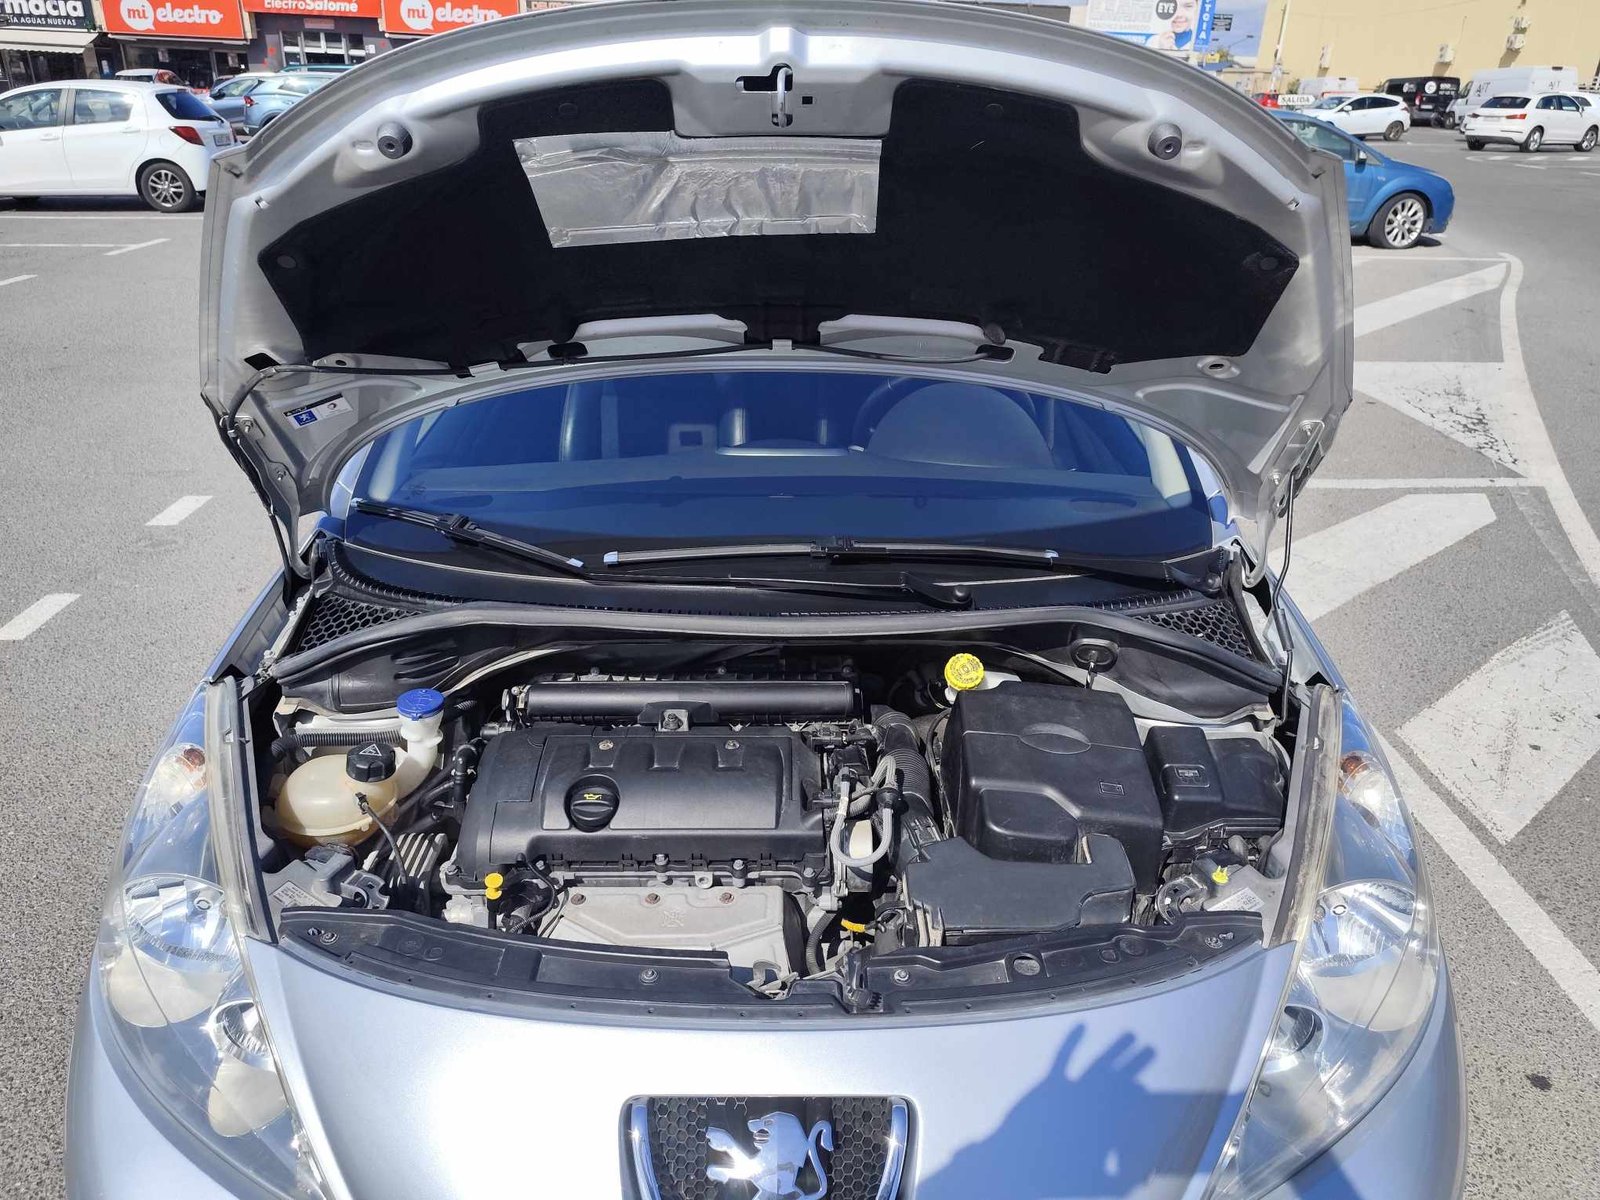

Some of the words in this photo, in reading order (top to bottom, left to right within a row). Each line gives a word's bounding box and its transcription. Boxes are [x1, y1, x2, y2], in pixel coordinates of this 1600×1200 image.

[127, 5, 148, 19] mi
[156, 2, 223, 24] electro
[407, 5, 426, 19] mi
[1158, 2, 1174, 13] EYE
[20, 17, 46, 25] AGUAS
[47, 17, 77, 26] NUEVAS
